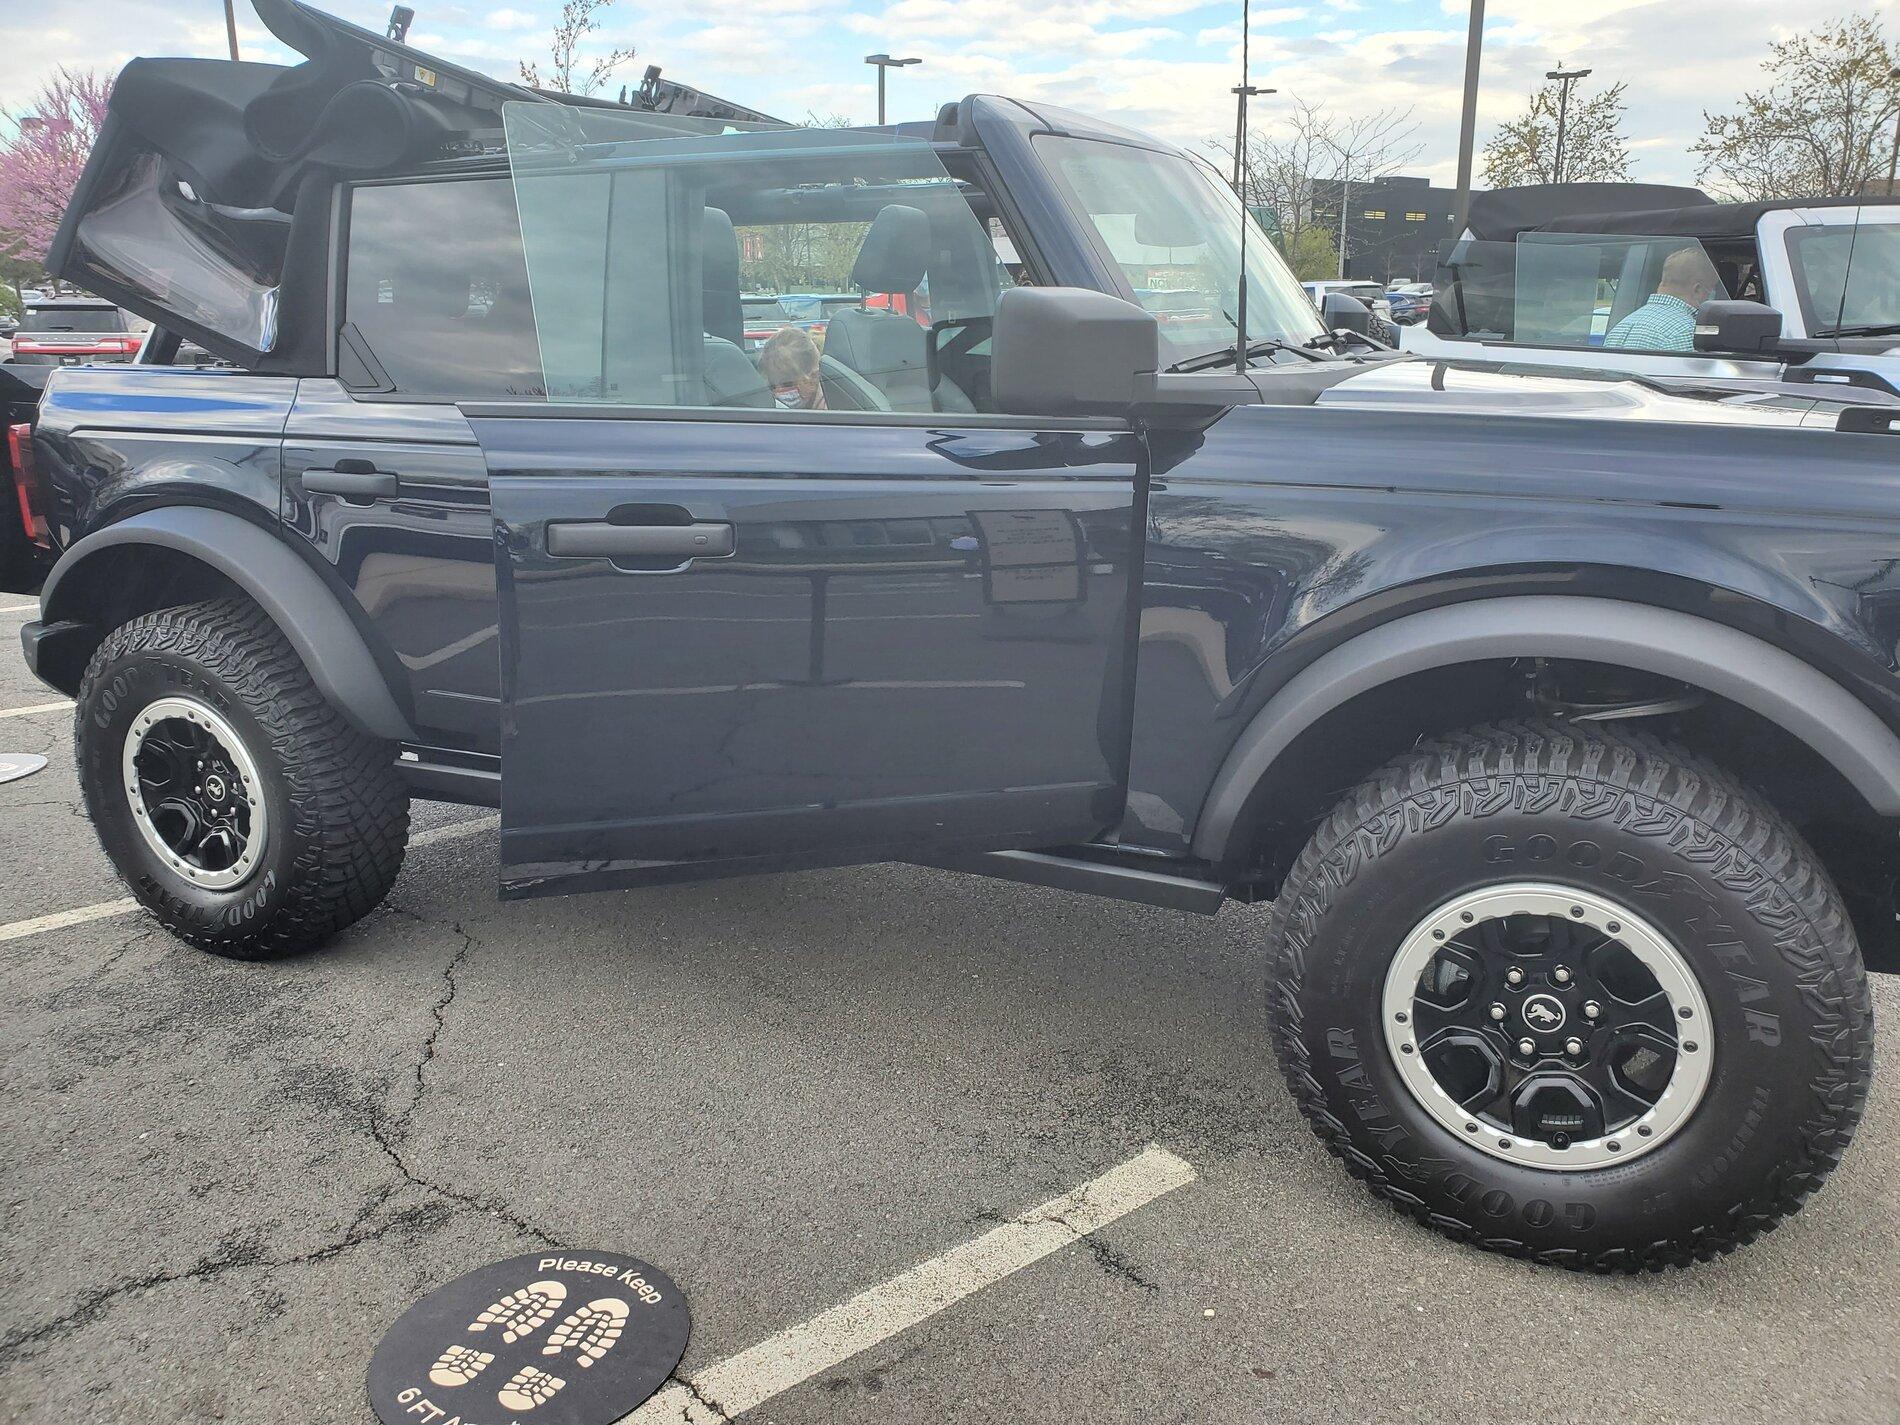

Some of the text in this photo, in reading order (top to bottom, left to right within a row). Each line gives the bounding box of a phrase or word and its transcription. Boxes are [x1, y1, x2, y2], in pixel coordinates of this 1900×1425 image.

[538, 1258, 662, 1305] Please Keep
[397, 1387, 422, 1404] 6
[406, 1398, 446, 1424] FT
